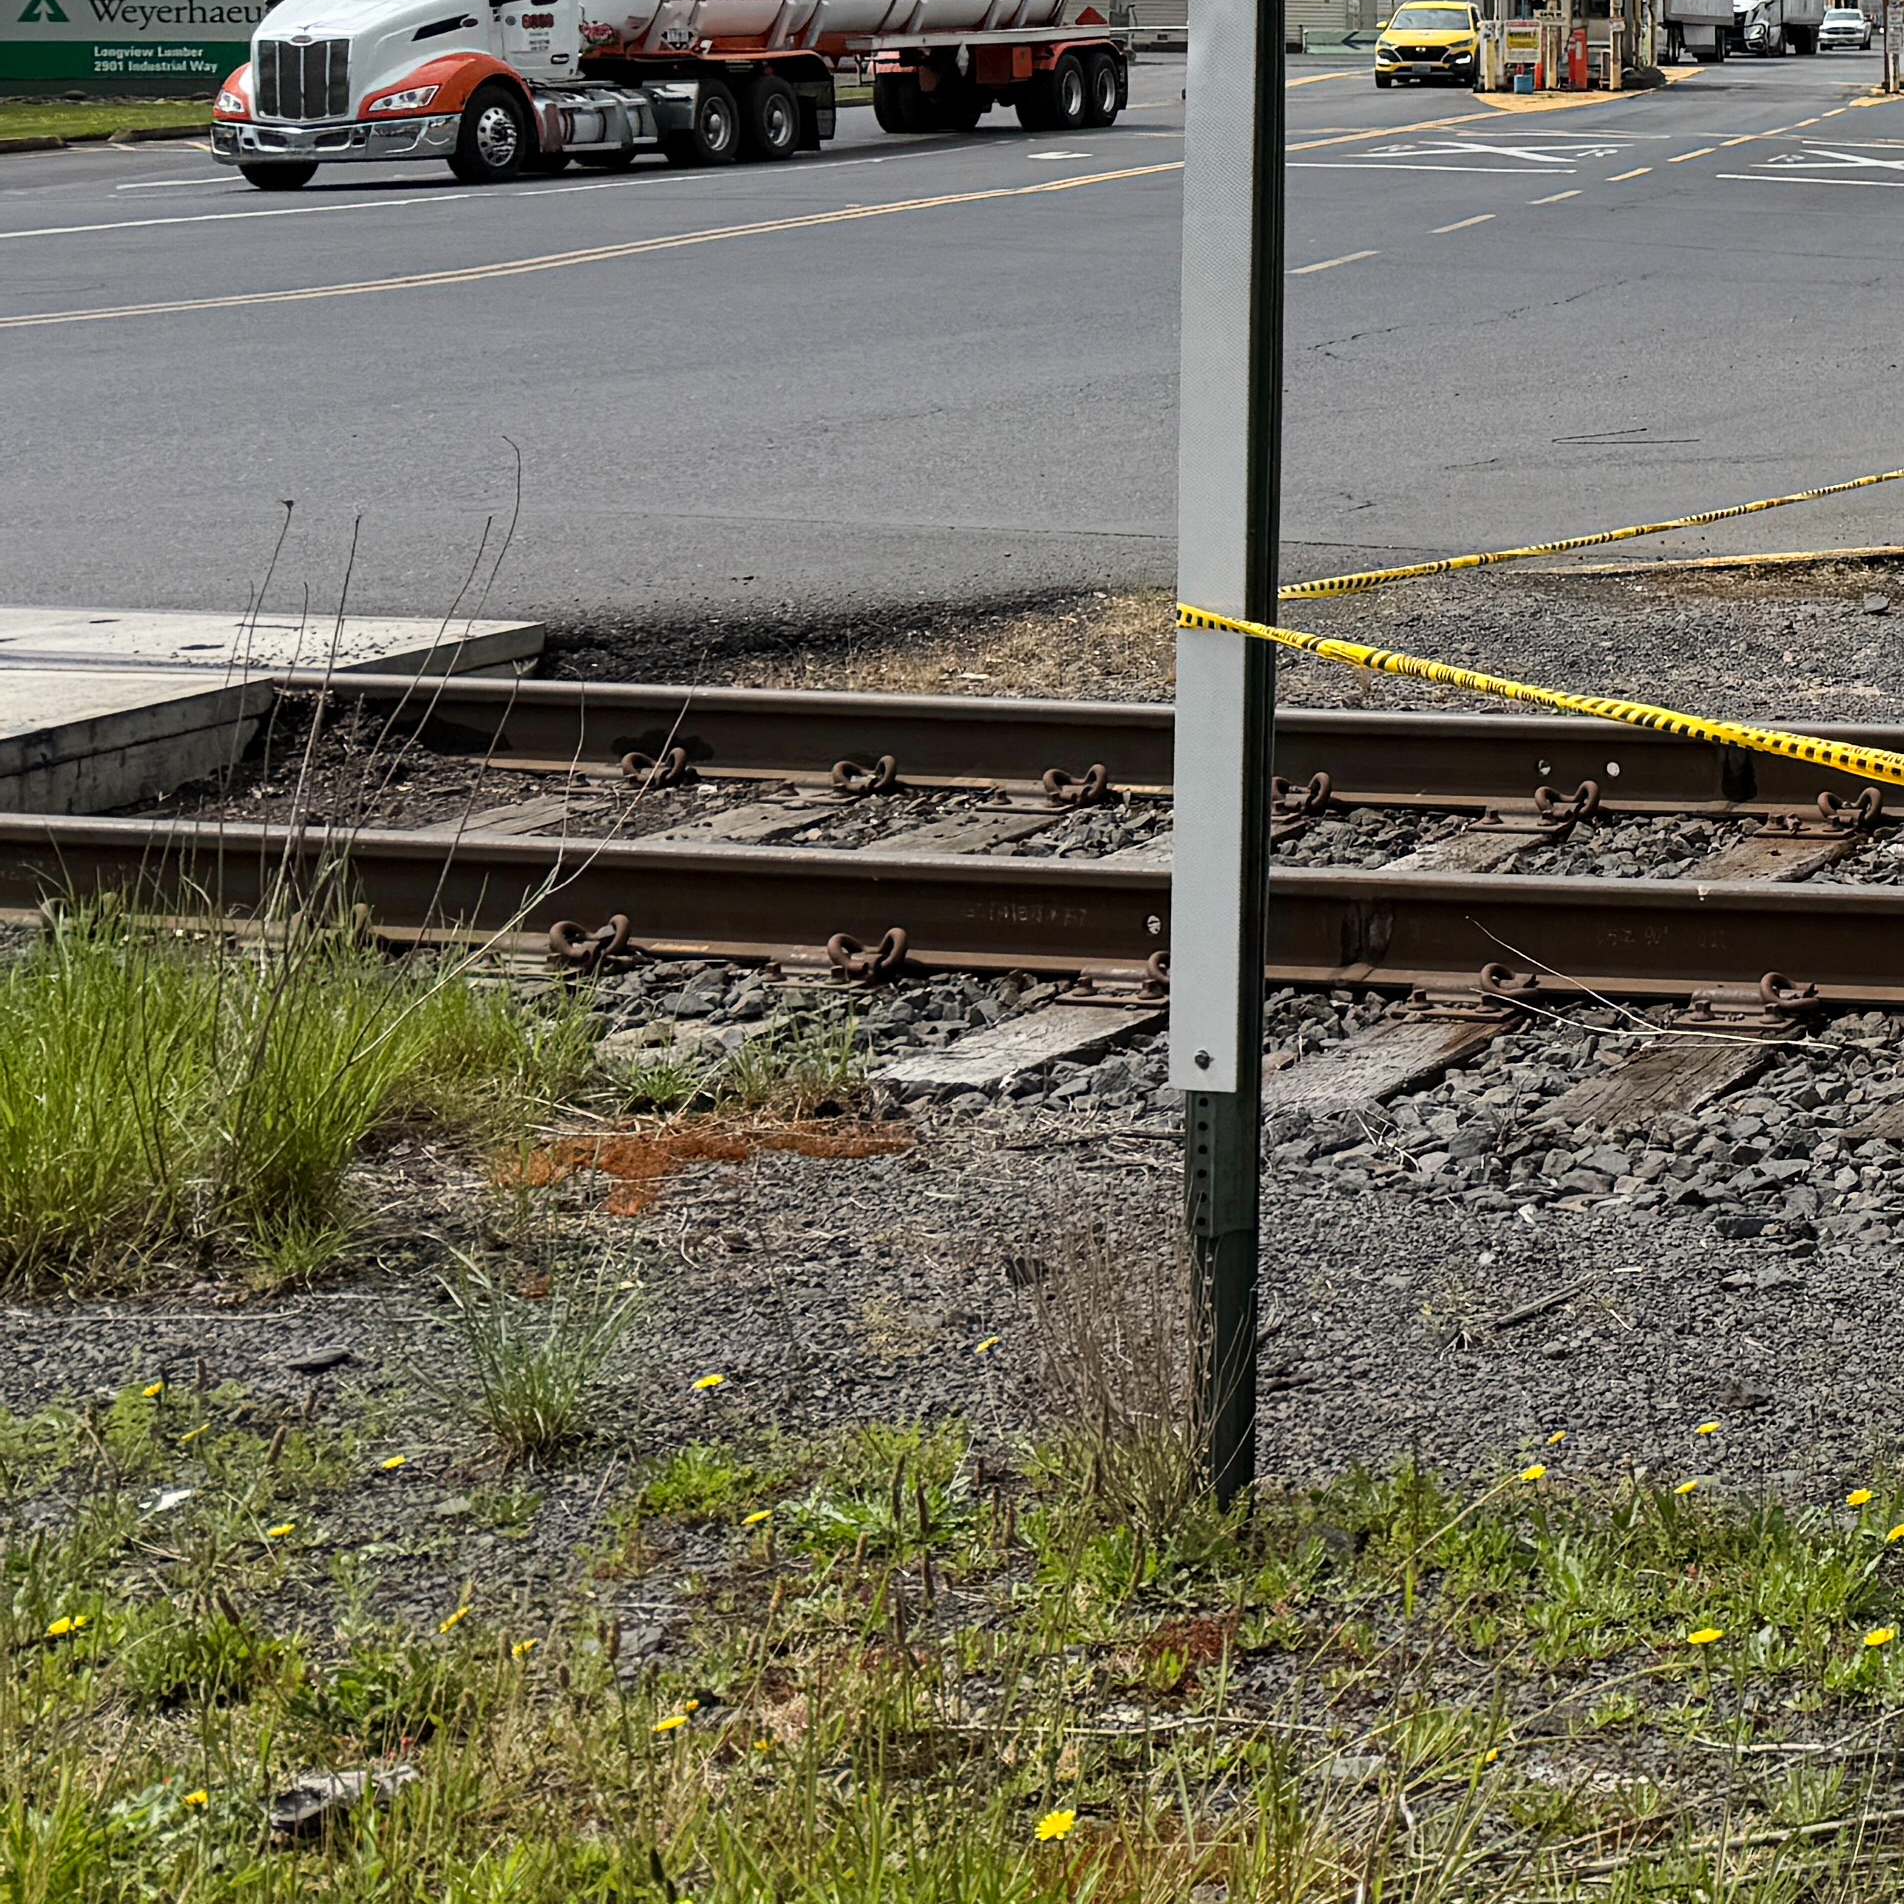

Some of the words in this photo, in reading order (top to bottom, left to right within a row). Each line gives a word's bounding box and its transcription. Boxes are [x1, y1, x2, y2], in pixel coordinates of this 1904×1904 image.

[94, 47, 154, 59] Longview
[157, 47, 203, 58] Lumber
[94, 61, 123, 72] 2901
[128, 61, 188, 72] Industrial
[190, 61, 218, 74] Way
